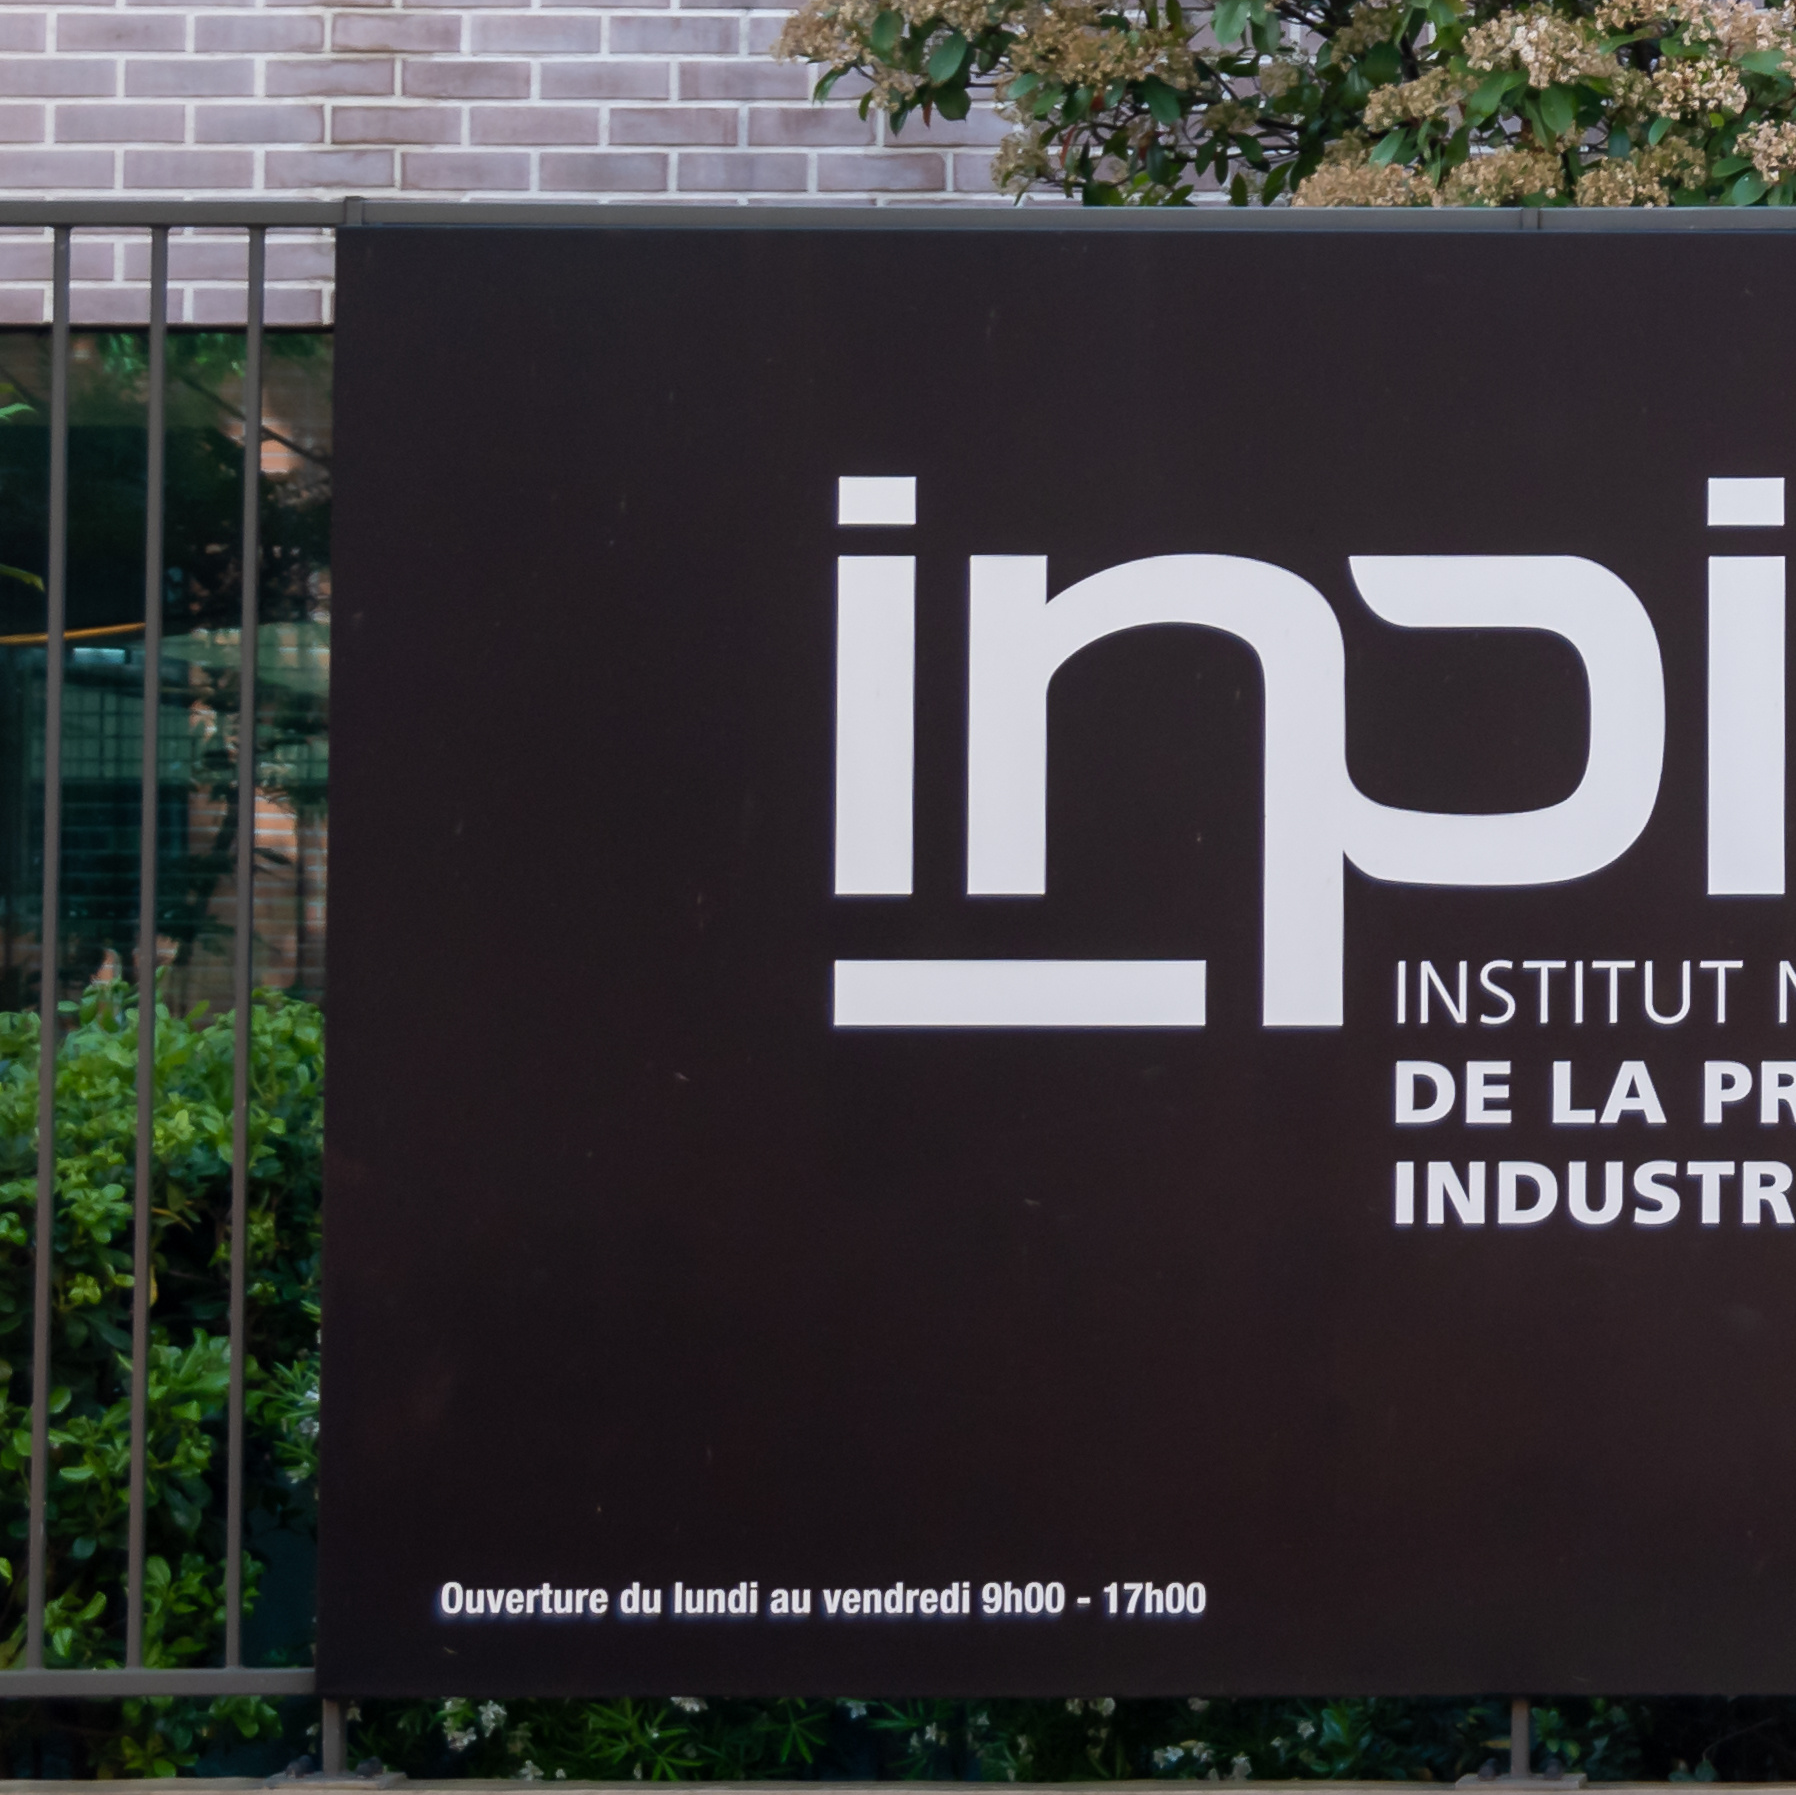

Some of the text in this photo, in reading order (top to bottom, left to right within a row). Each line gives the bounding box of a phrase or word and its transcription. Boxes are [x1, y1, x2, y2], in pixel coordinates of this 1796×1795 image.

[834, 475, 1786, 1027] inpi
[1396, 959, 1744, 1025] INSTITUT
[1394, 1060, 1513, 1124] DE
[1551, 1060, 1667, 1124] LA
[440, 1581, 609, 1615] Ouverture
[619, 1581, 662, 1615] du
[673, 1581, 758, 1614] lundi
[769, 1588, 811, 1615] au
[822, 1581, 970, 1614] vendredi
[981, 1581, 1066, 1614] 9h00
[1103, 1581, 1207, 1615] 17h00
